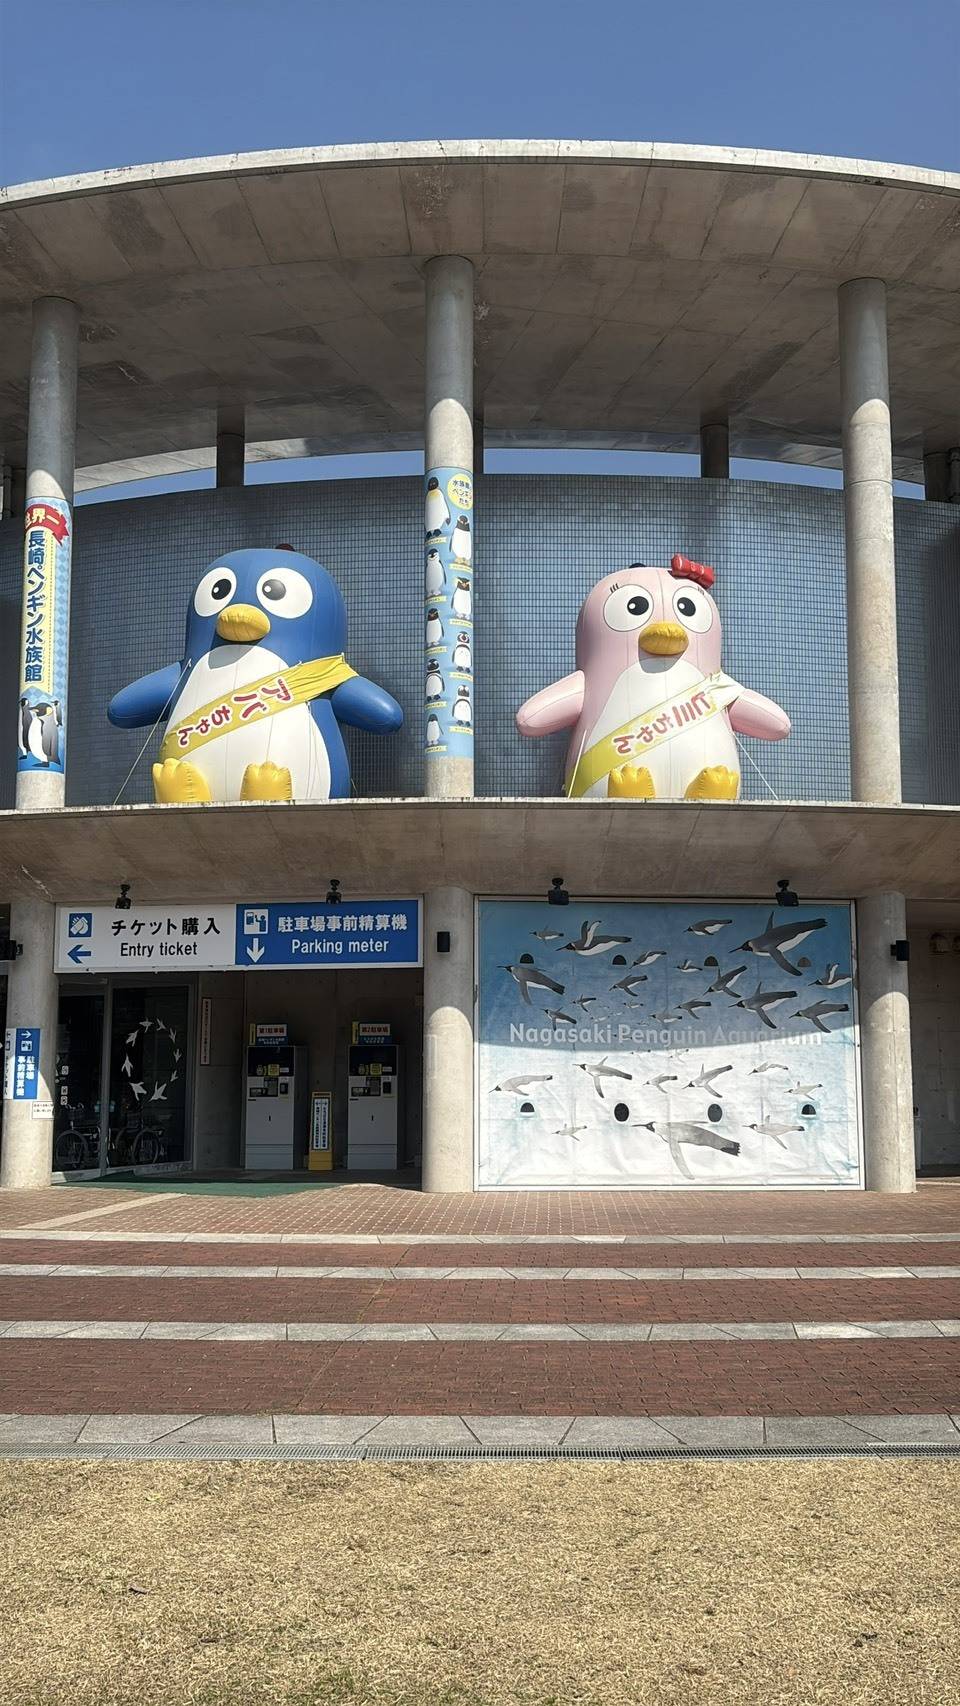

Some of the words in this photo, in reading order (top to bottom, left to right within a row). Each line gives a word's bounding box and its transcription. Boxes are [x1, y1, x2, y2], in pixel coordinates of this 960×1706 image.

[24, 530, 45, 682] 長崎ペンギン水族館
[111, 916, 221, 937] チケット購入
[278, 914, 408, 933] 駐車場事前精算機
[120, 942, 154, 958] Entry
[159, 941, 198, 956] ticket
[291, 938, 343, 956] Parking
[348, 937, 390, 953] meter
[510, 1023, 612, 1048] Nagasaki
[618, 1024, 707, 1048] Penguin
[713, 1026, 822, 1048] Aquarium
